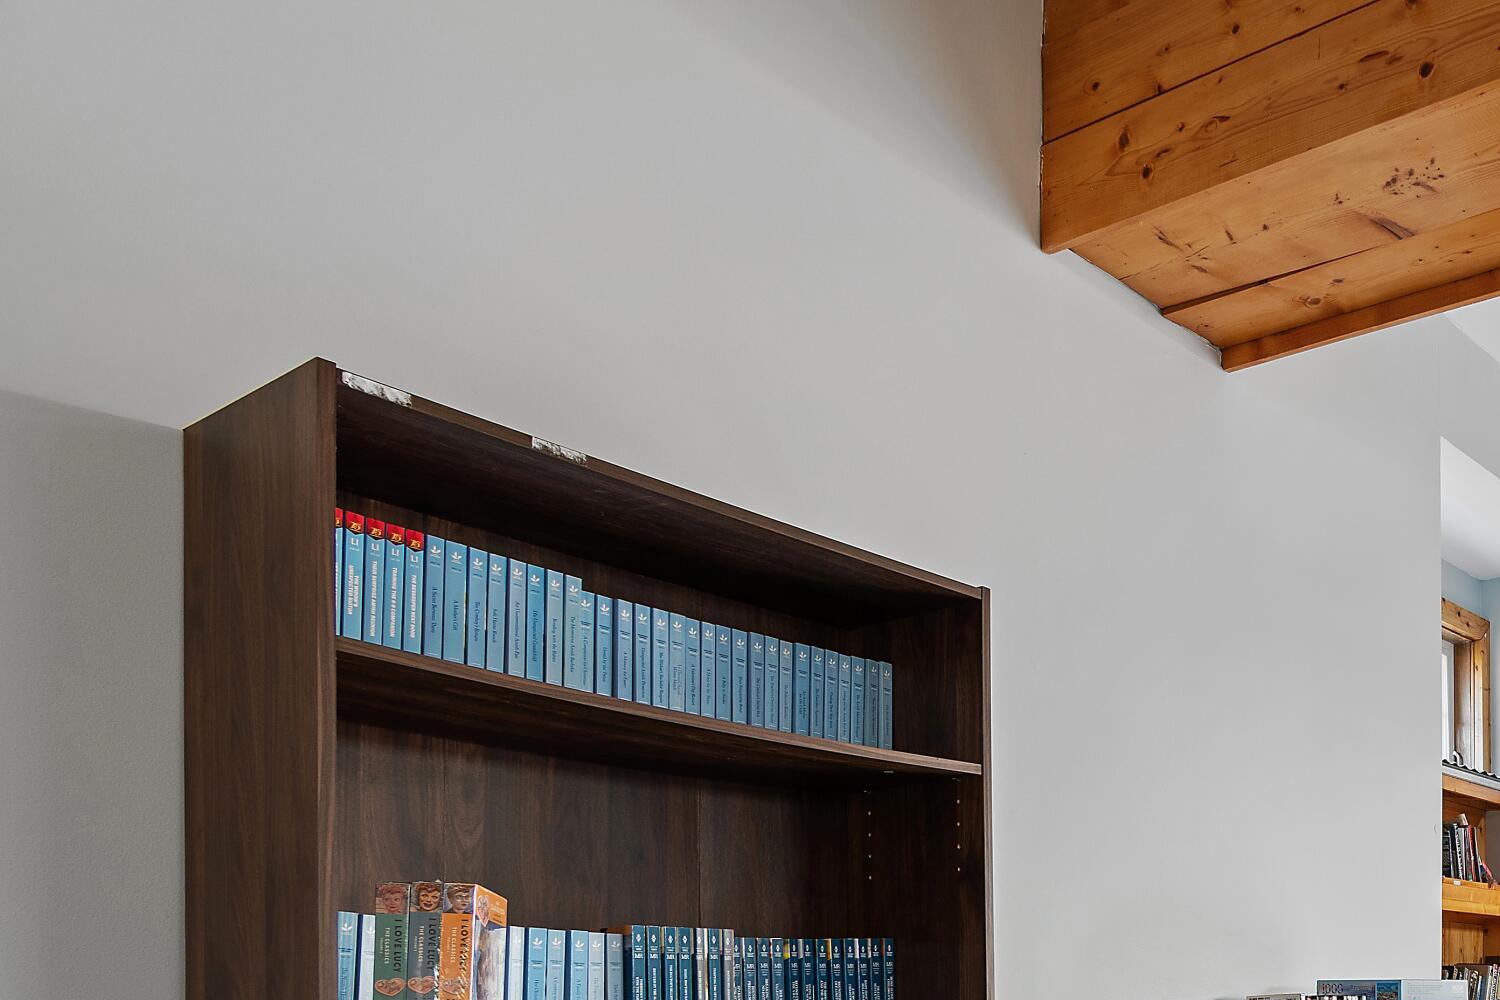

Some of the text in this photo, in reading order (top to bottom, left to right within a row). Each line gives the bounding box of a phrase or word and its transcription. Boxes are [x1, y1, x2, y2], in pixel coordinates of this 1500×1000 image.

[370, 576, 378, 599] SURPRISE
[410, 575, 418, 584] THE
[410, 585, 418, 611] BEEKEEPER
[369, 616, 377, 637] REUNION
[409, 625, 417, 638] DOOR
[394, 925, 402, 948] LOVE
[427, 923, 435, 946] LOVE
[427, 948, 435, 970] LUCY
